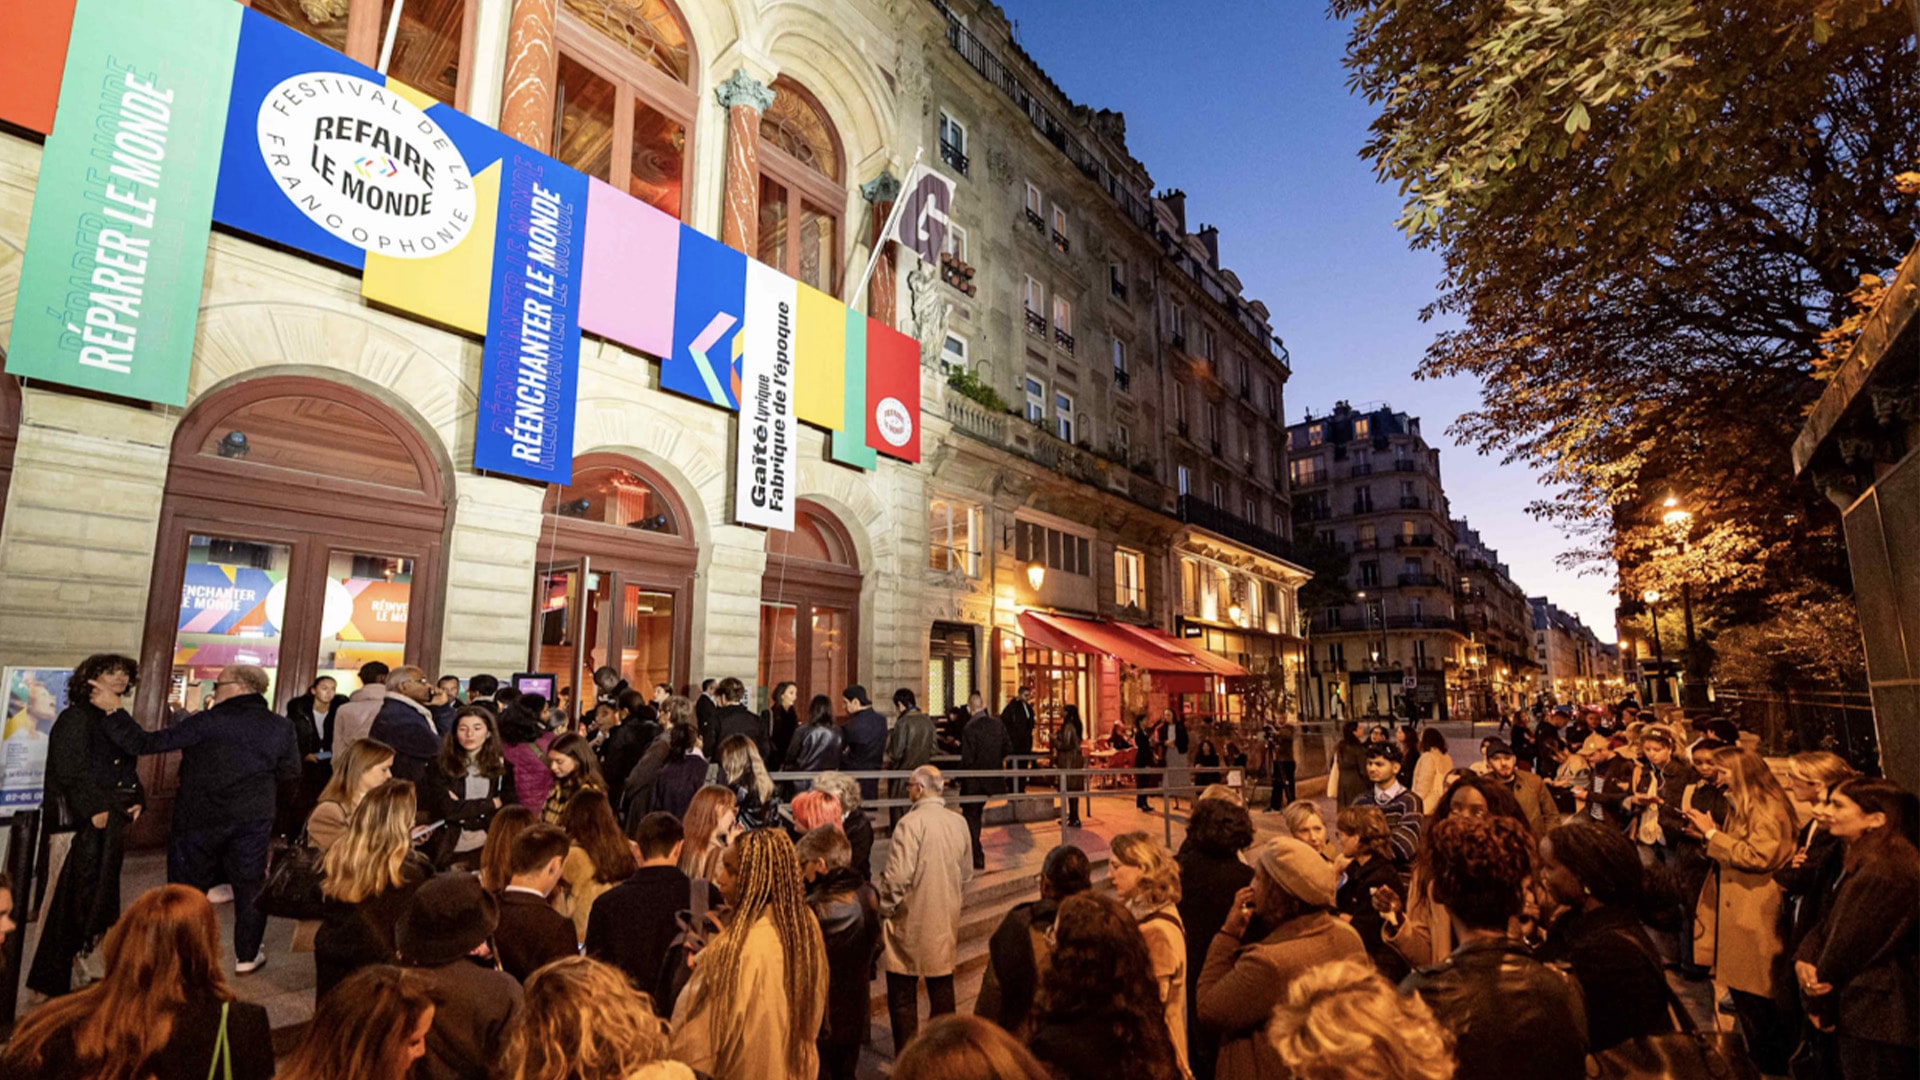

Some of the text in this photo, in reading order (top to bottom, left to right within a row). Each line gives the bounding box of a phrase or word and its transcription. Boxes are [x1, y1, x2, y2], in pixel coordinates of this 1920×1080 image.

[110, 72, 174, 188] MONDE
[272, 78, 468, 191] FESTIVAL DE LA
[311, 143, 433, 217] LE MONDE
[314, 116, 436, 190] REFAIRE
[103, 183, 157, 228] LE
[266, 132, 469, 253] FRANCOPHONIE
[527, 182, 561, 269] MONDE
[67, 228, 151, 374] RÉPARER
[525, 265, 554, 298] LE
[504, 297, 553, 463] RÉENCHANTER
[769, 301, 791, 512] Fabrique de l'époque
[751, 373, 772, 508] Gaîté Lyrique
[194, 598, 241, 611] MONDE
